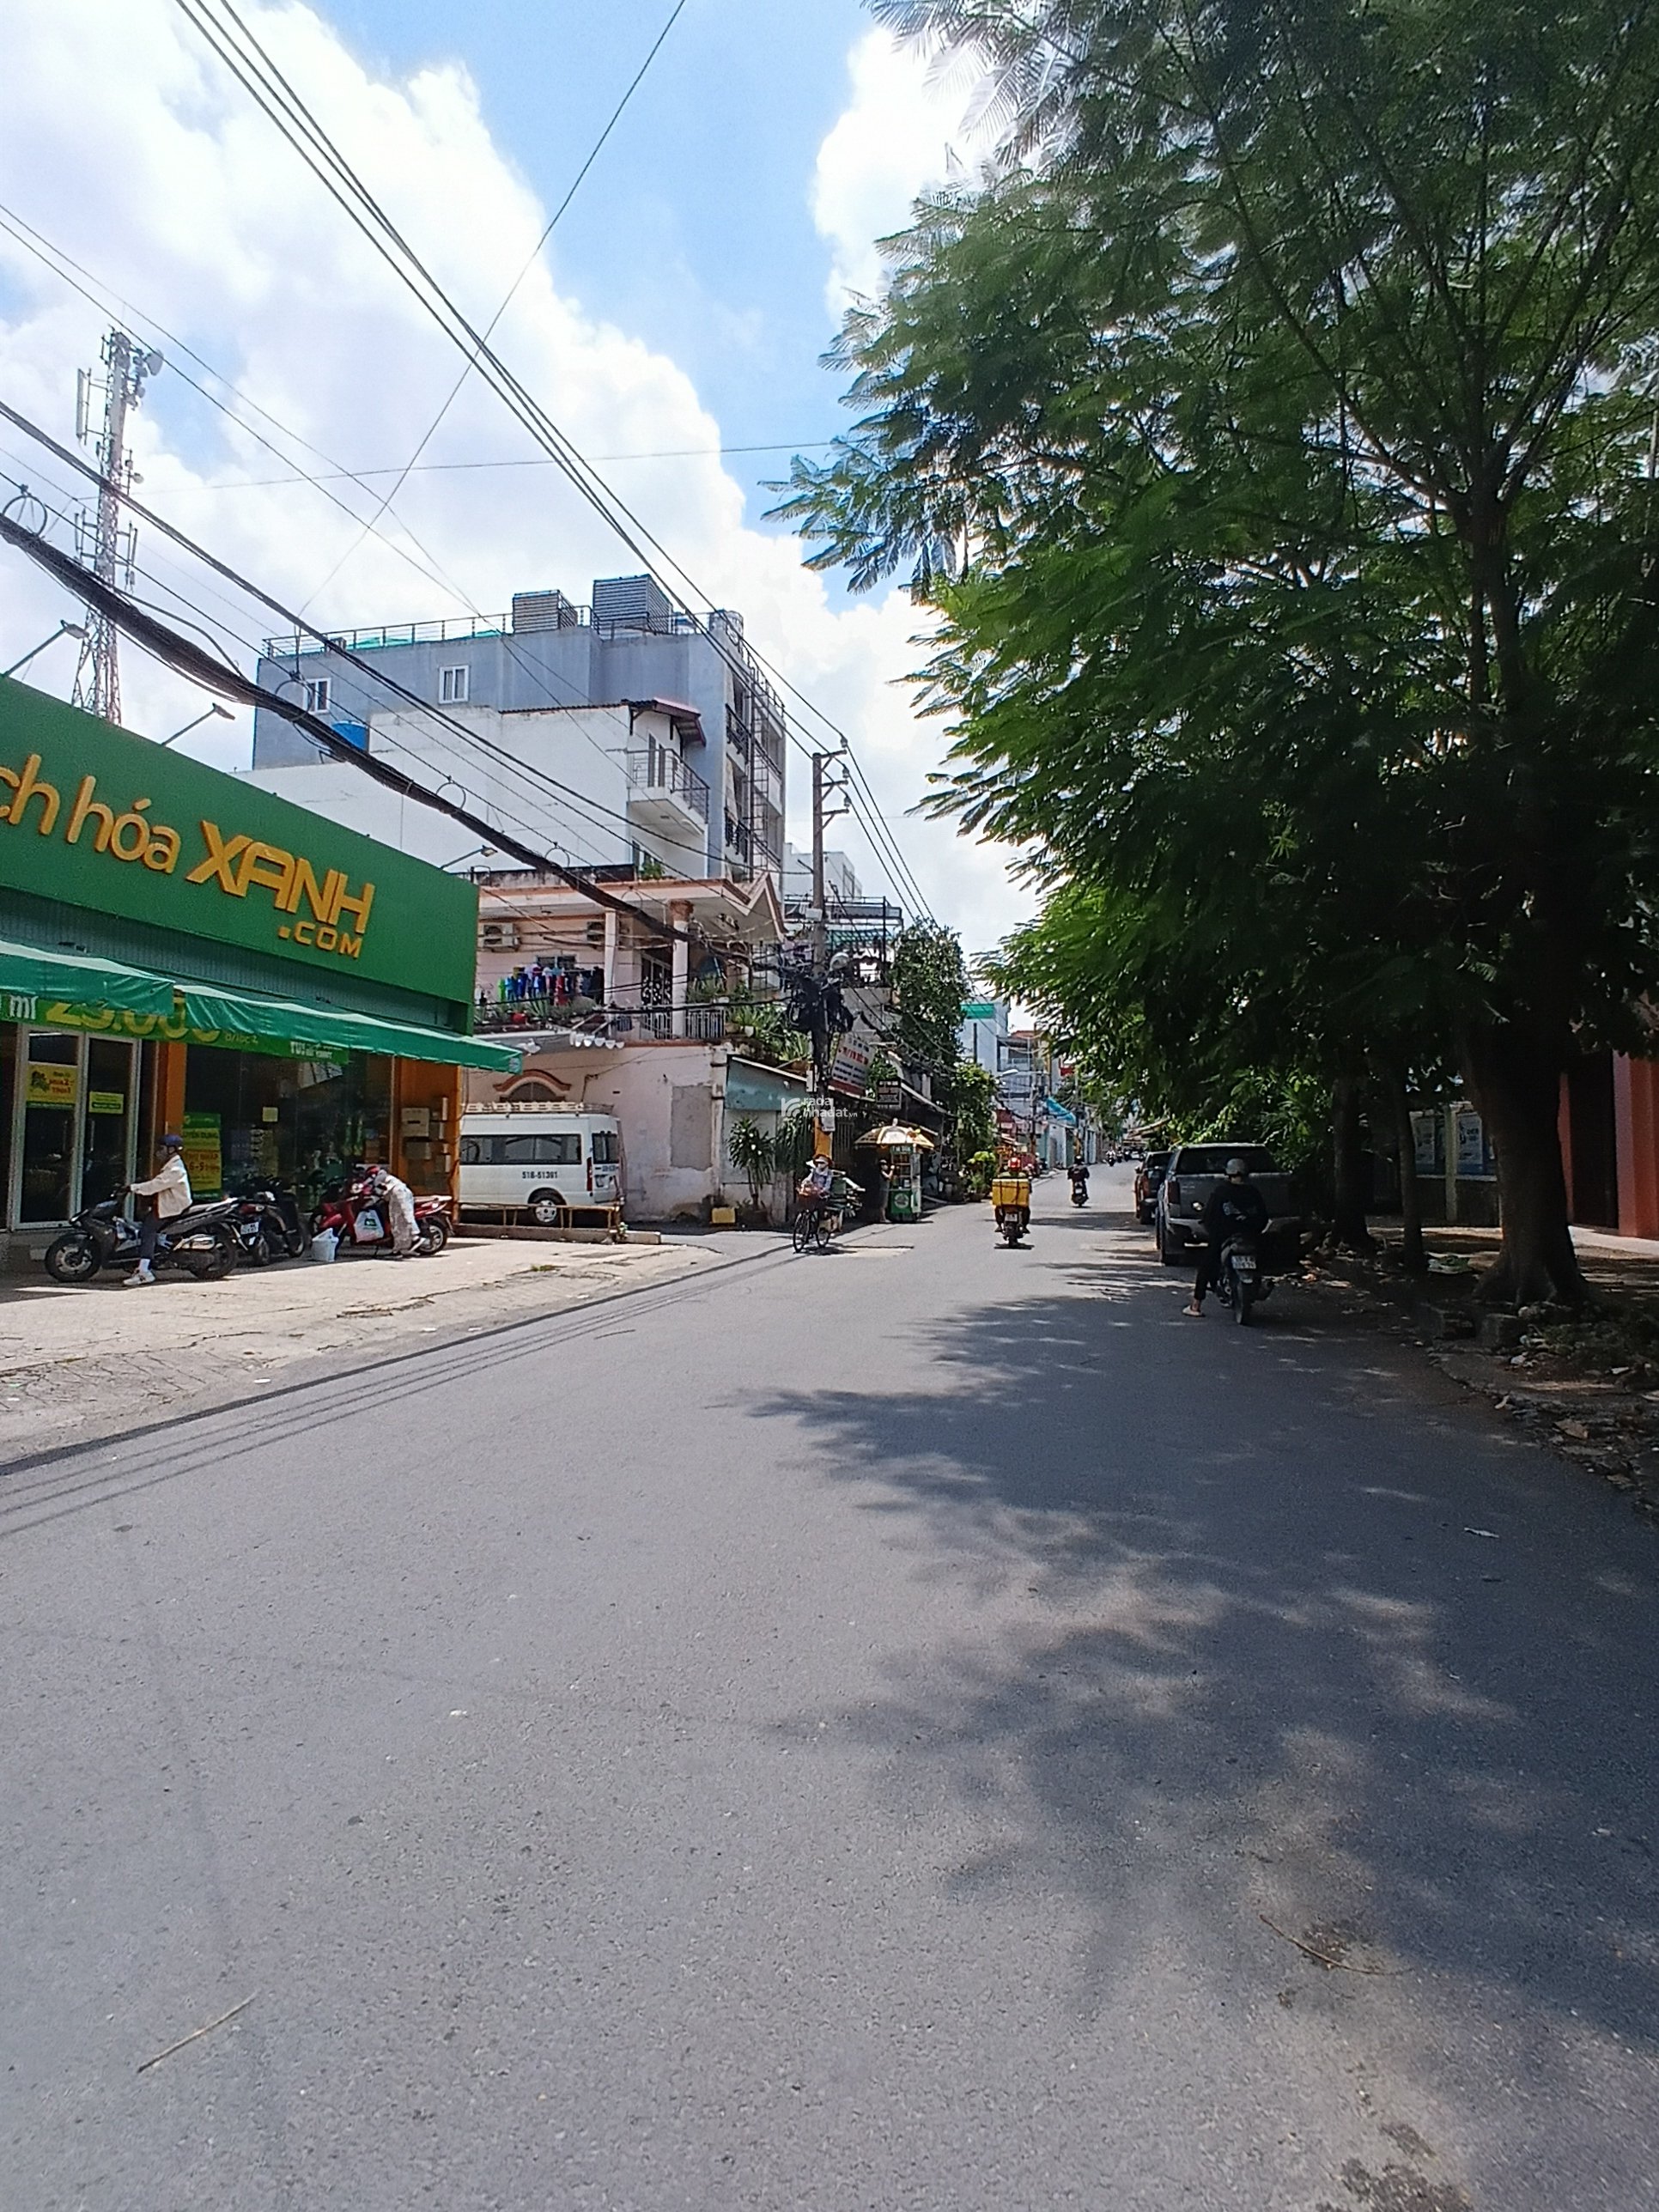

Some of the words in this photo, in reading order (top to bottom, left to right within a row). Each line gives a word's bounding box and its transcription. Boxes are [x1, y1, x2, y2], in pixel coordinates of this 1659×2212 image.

[66, 775, 181, 874] hóa
[185, 819, 375, 934] XANH
[277, 921, 362, 958] .COM
